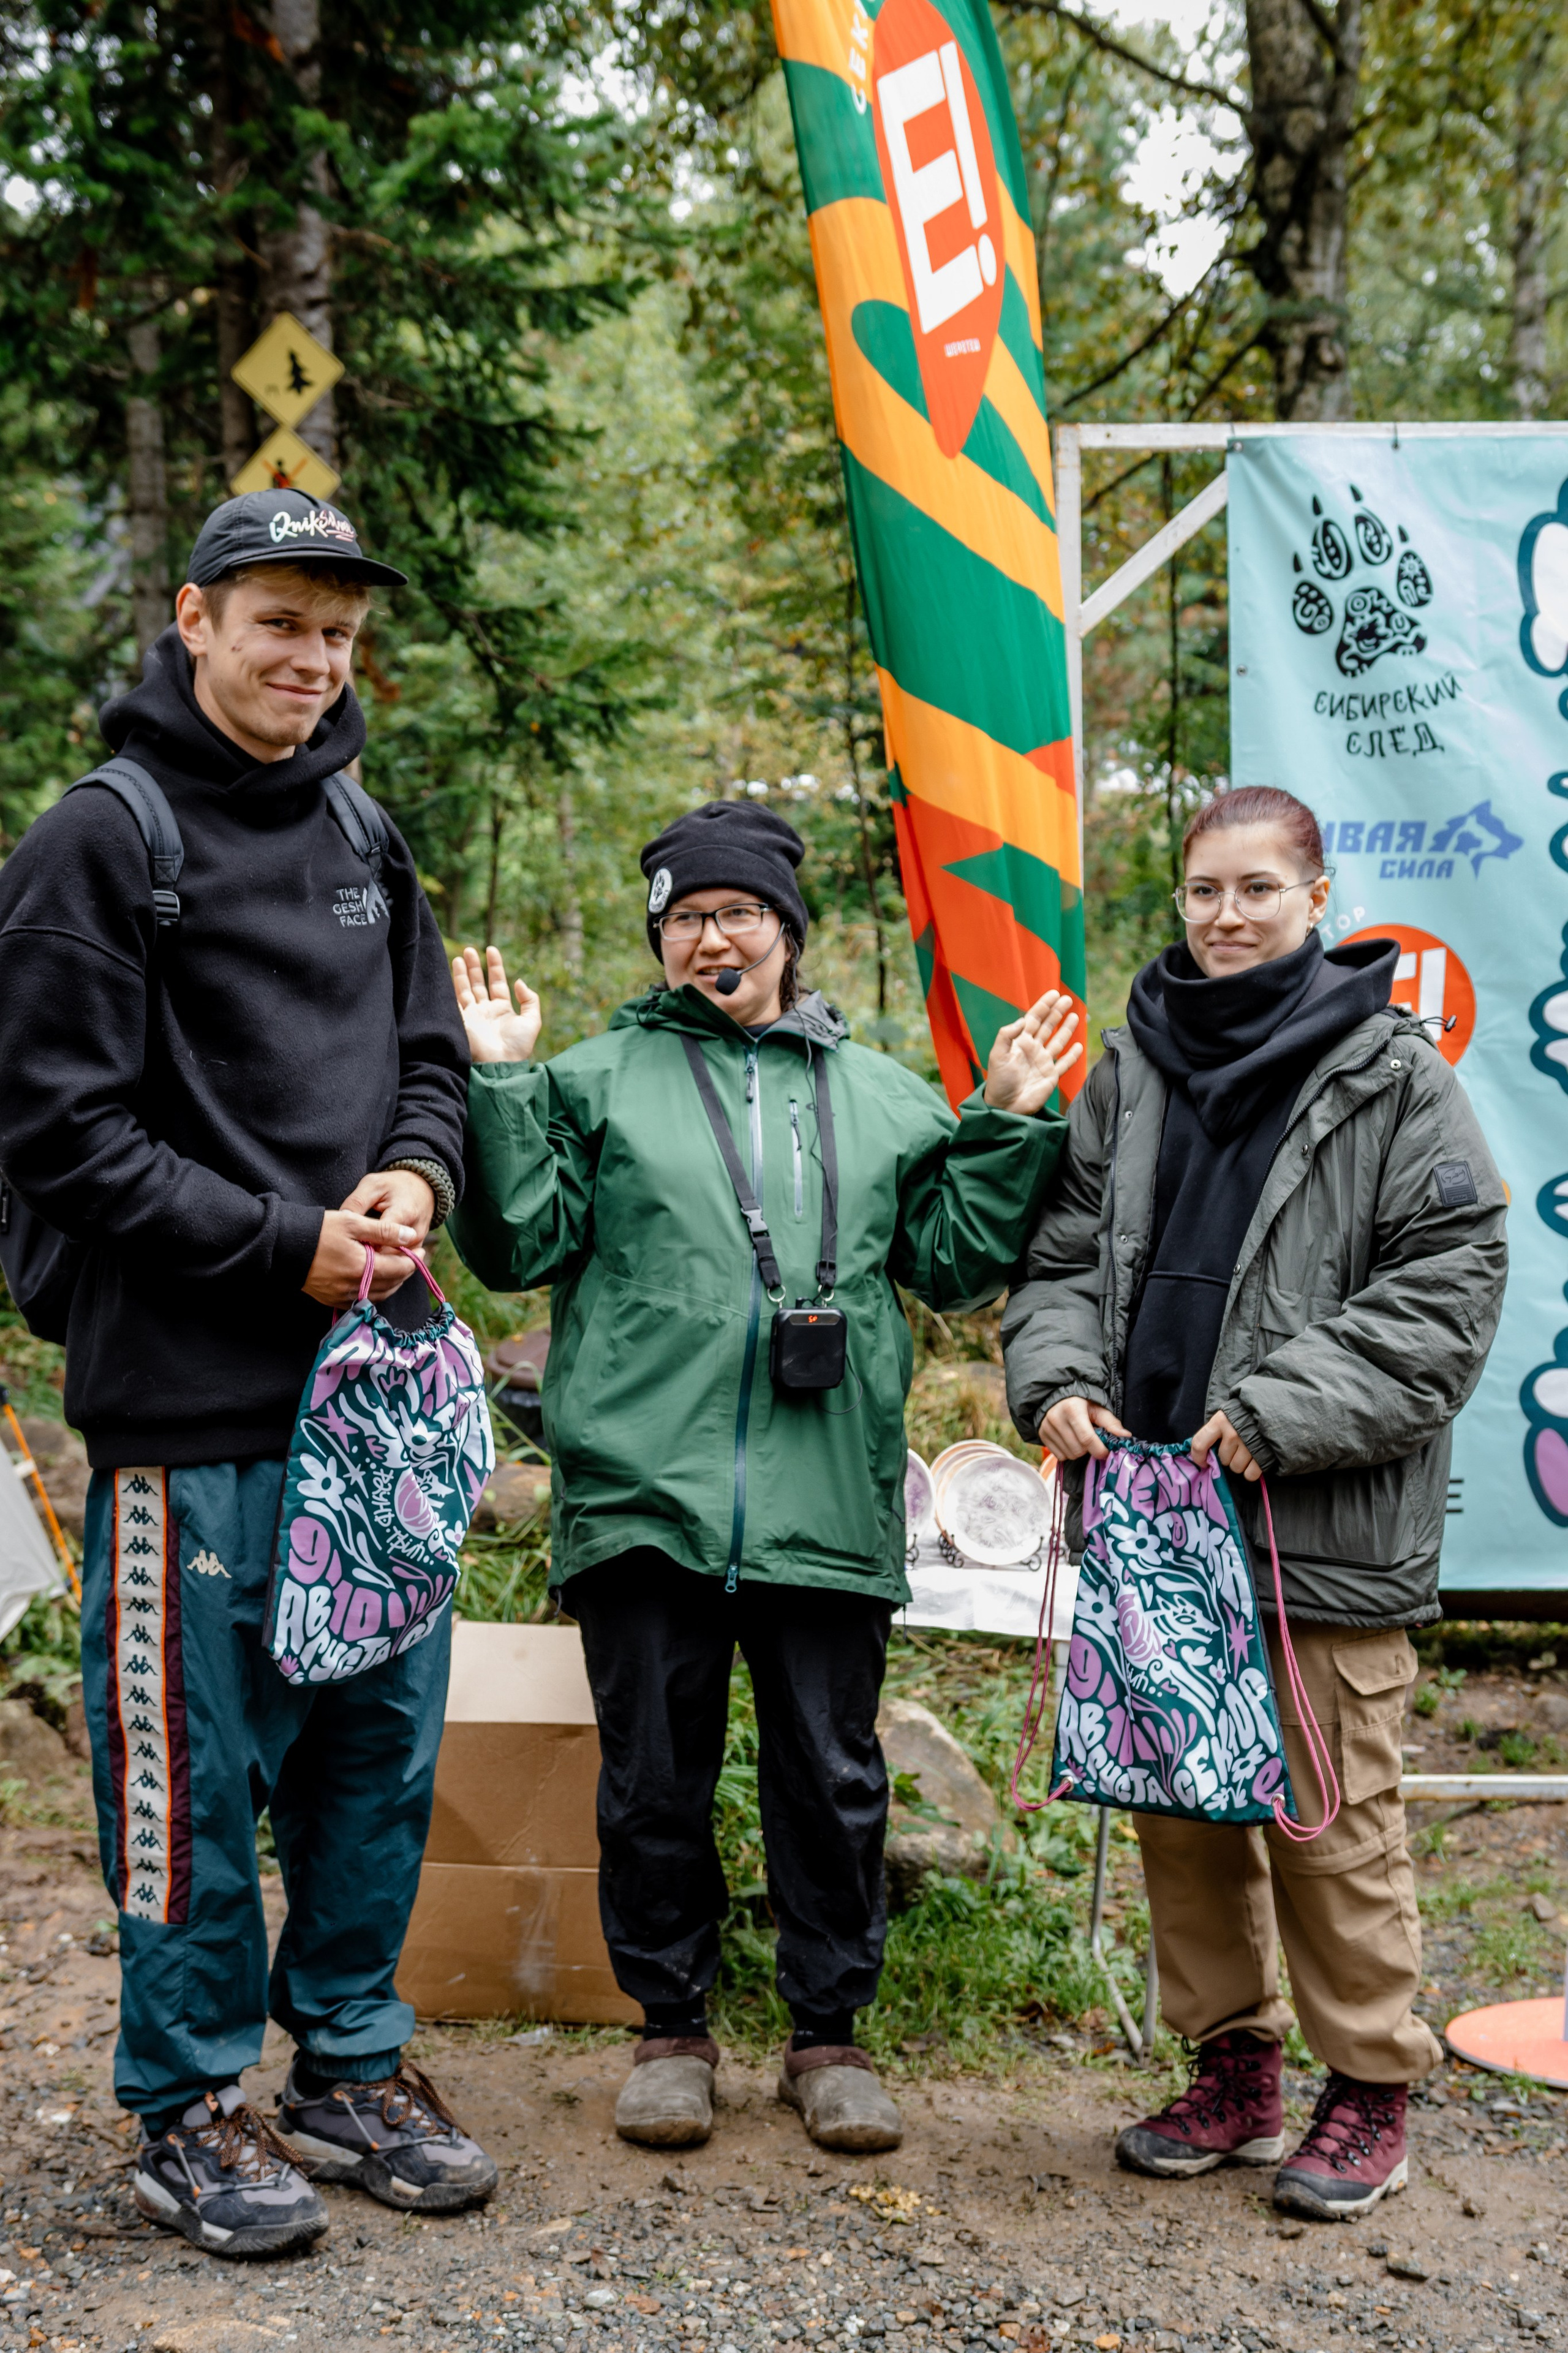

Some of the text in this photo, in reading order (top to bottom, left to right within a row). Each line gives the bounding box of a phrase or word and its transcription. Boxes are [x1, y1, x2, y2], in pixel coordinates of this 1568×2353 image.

[1314, 671, 1463, 720] СИБИРСКИЙ
[1379, 859, 1454, 879] СИЛА
[336, 887, 360, 901] THE
[333, 900, 365, 915] GESH
[339, 913, 368, 928] FACE
